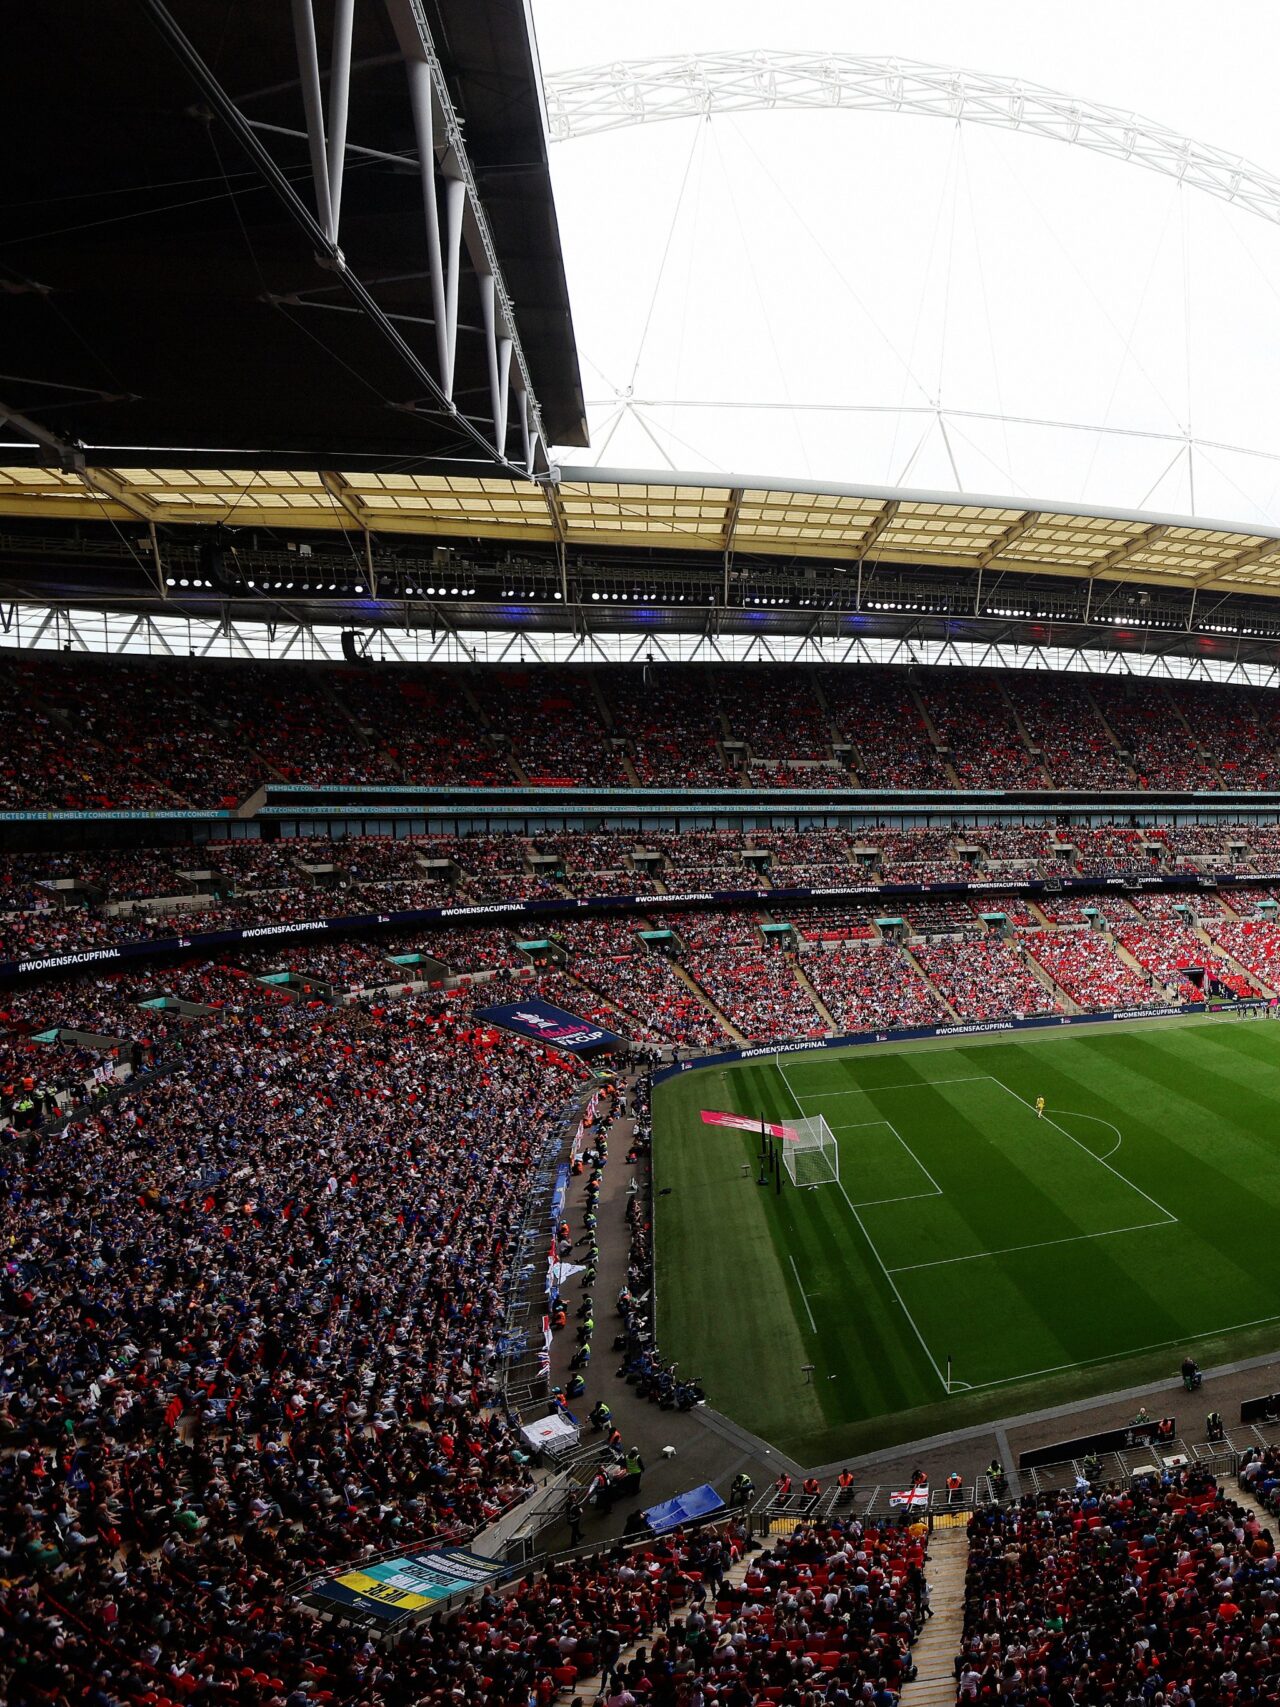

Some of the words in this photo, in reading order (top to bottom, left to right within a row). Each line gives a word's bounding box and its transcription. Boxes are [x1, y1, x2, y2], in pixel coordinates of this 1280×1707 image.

[635, 893, 714, 903] #WOMENSFACUPFINAL
[442, 902, 525, 916] #WOMENSFACUPFINAL
[242, 921, 328, 938] #WOMENSFACUPFINAL
[21, 948, 120, 972] #WOMENSFACUPFINAL
[1113, 1008, 1181, 1018] #WOMENSFACUPFINAL
[936, 1022, 1013, 1035] #WOMENSFACUPFINAL
[557, 1038, 580, 1046] FA
[575, 1031, 604, 1043] CUP
[741, 1040, 827, 1057] #WOMENSFACUPFINAL
[399, 1564, 459, 1587] TOGETHER
[362, 1583, 409, 1604] WE'RE
